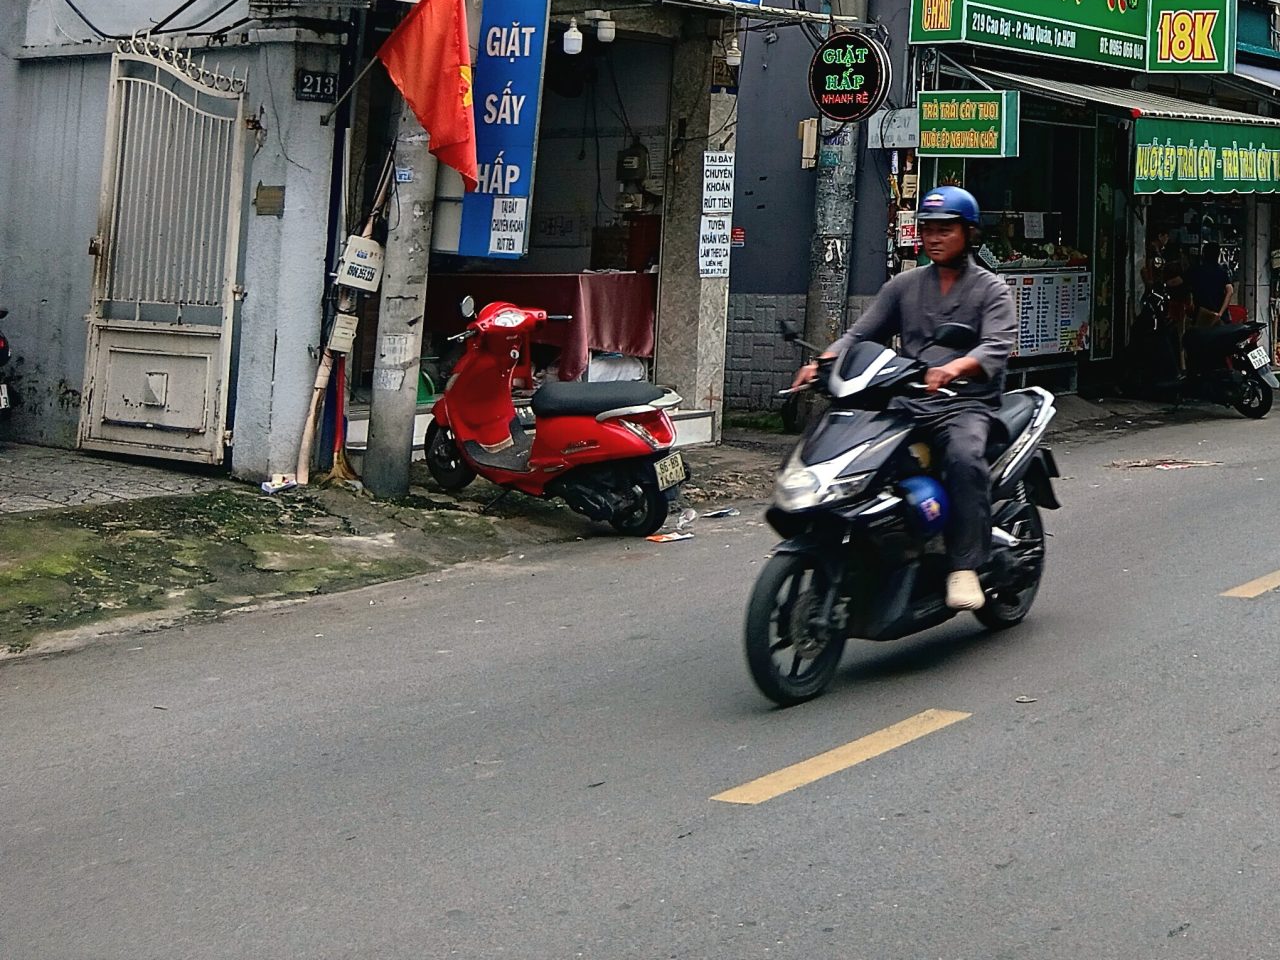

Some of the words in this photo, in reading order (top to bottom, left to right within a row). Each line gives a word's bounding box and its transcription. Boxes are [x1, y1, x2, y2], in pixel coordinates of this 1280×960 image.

[972, 12, 985, 32] 219
[986, 15, 998, 34] Cao
[999, 17, 1011, 40] Đạt
[1022, 23, 1035, 45] Chợ
[1157, 9, 1220, 63] 18K
[486, 22, 536, 62] GIẶT
[823, 44, 869, 67] GIẶT
[303, 75, 334, 94] 213
[826, 68, 865, 91] HẤP
[484, 81, 526, 125] SẤY
[822, 94, 854, 104] NHANH
[922, 99, 938, 120] TRÀ
[940, 99, 958, 120] TRÁI
[960, 99, 977, 120] CÂY
[950, 128, 979, 148] NGUYÊN
[718, 153, 733, 163] ĐÂY
[1135, 137, 1164, 180] NƯỚC
[1164, 138, 1176, 180] ÉP
[1177, 139, 1197, 180] TRÁI
[1199, 139, 1216, 181] CÂY
[1222, 141, 1239, 181] TRÀ
[1239, 141, 1257, 181] TRÁI
[1257, 142, 1271, 181] CÂY
[474, 151, 520, 195] HẤP
